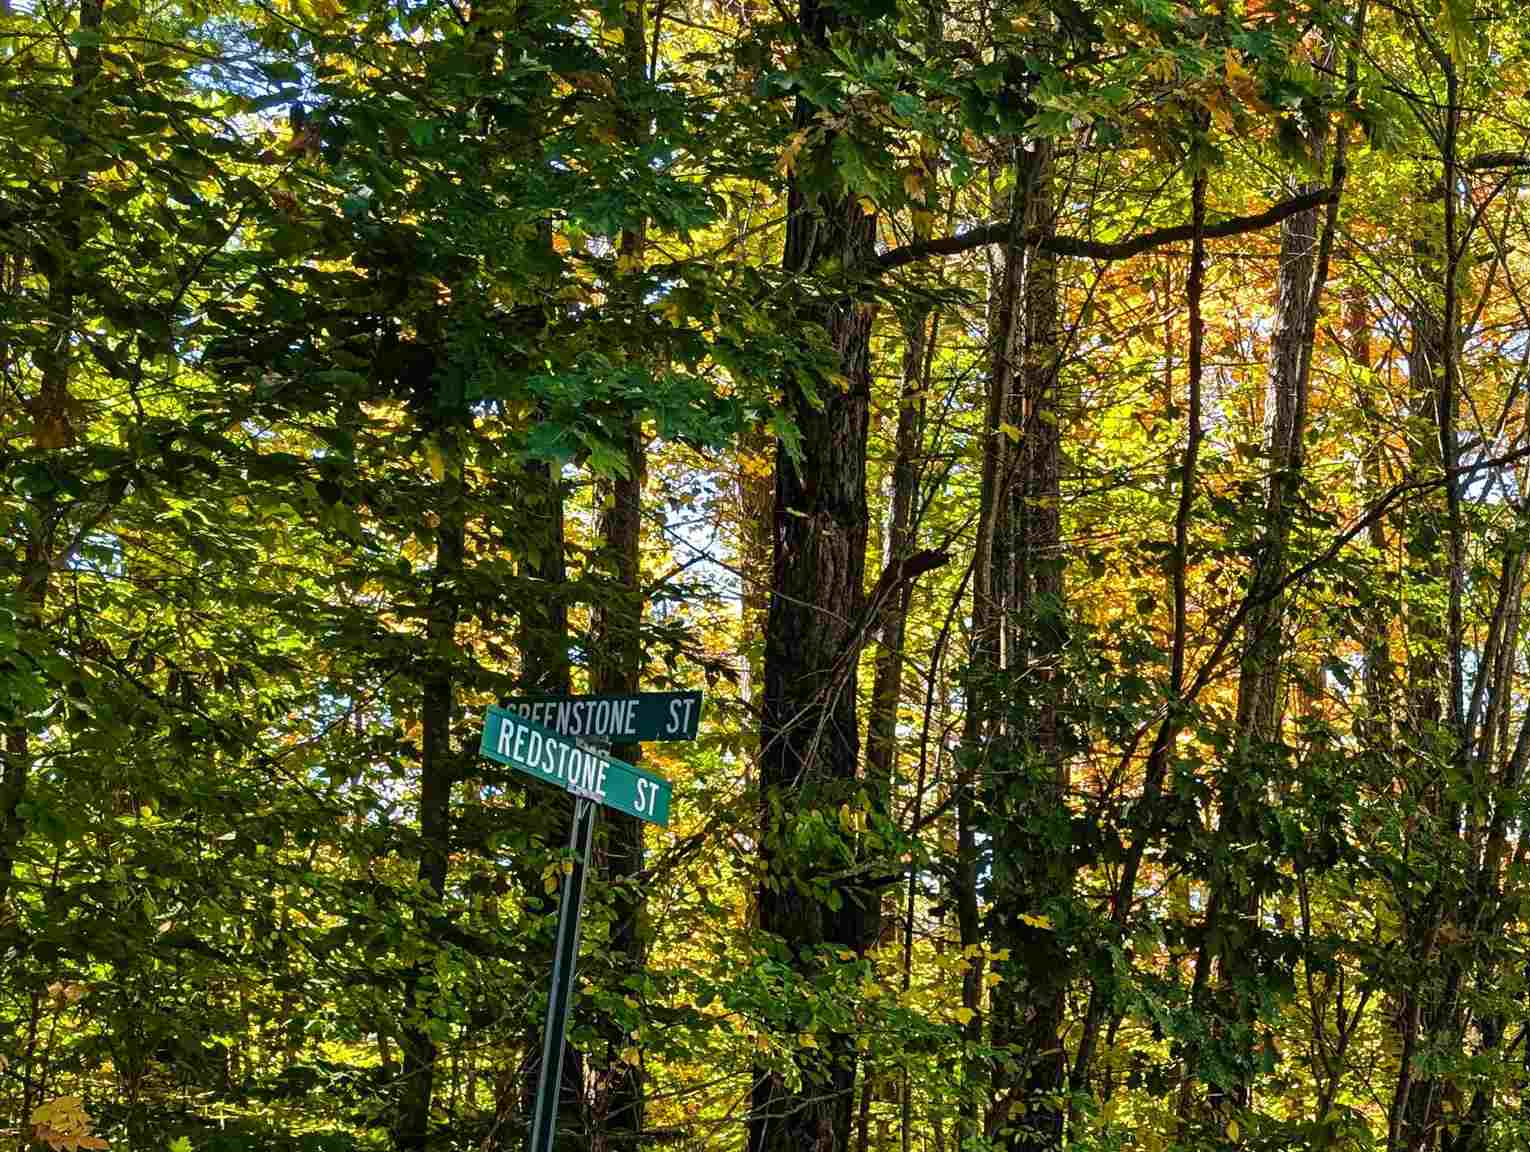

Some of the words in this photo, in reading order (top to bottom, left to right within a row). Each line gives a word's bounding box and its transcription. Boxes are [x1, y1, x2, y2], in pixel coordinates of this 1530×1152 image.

[666, 698, 695, 735] ST
[497, 718, 609, 797] REDSTONE
[634, 777, 659, 816] ST
